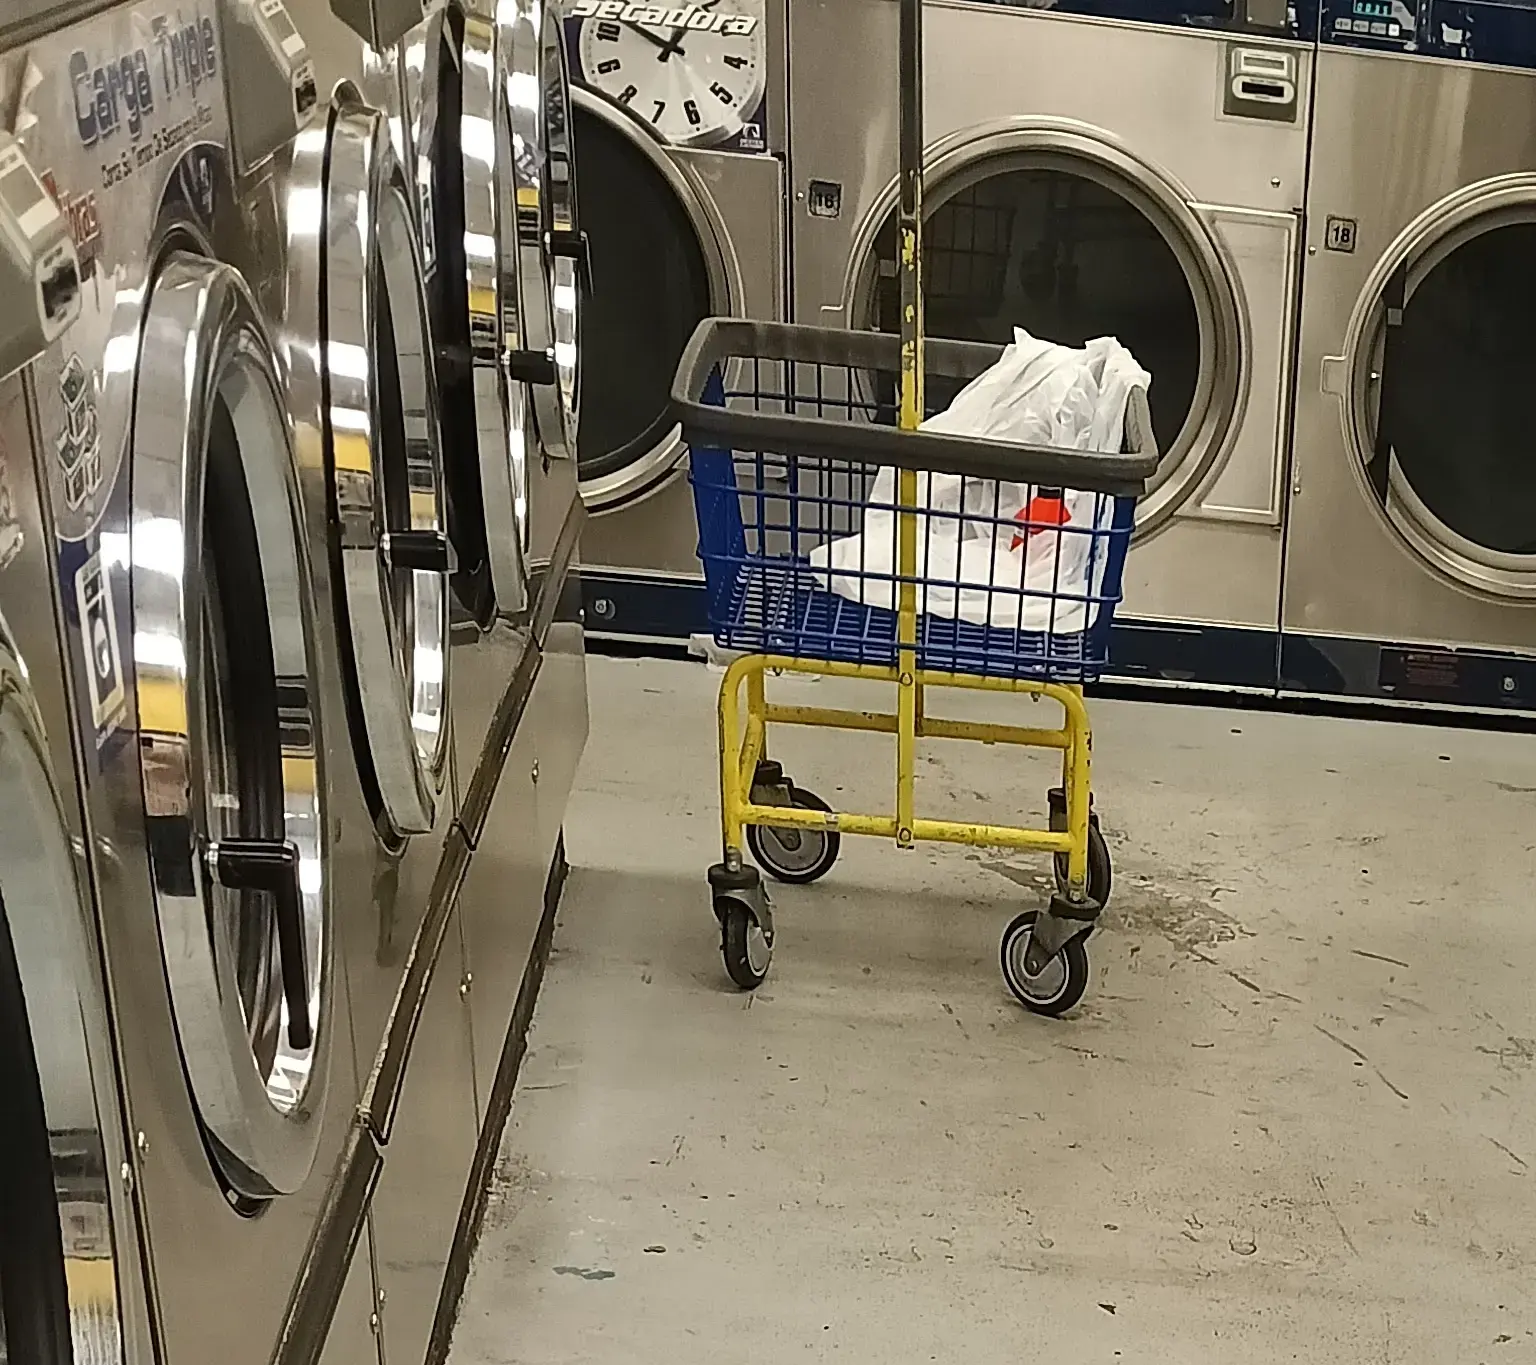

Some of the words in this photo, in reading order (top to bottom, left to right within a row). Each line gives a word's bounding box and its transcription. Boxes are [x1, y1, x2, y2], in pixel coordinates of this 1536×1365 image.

[596, 22, 620, 42] 10
[597, 59, 621, 75] 9
[723, 55, 748, 70] 4
[70, 51, 153, 145] Carga
[617, 84, 638, 105] 8
[709, 82, 733, 105] 5
[651, 100, 666, 124] 7
[684, 100, 700, 125] 6
